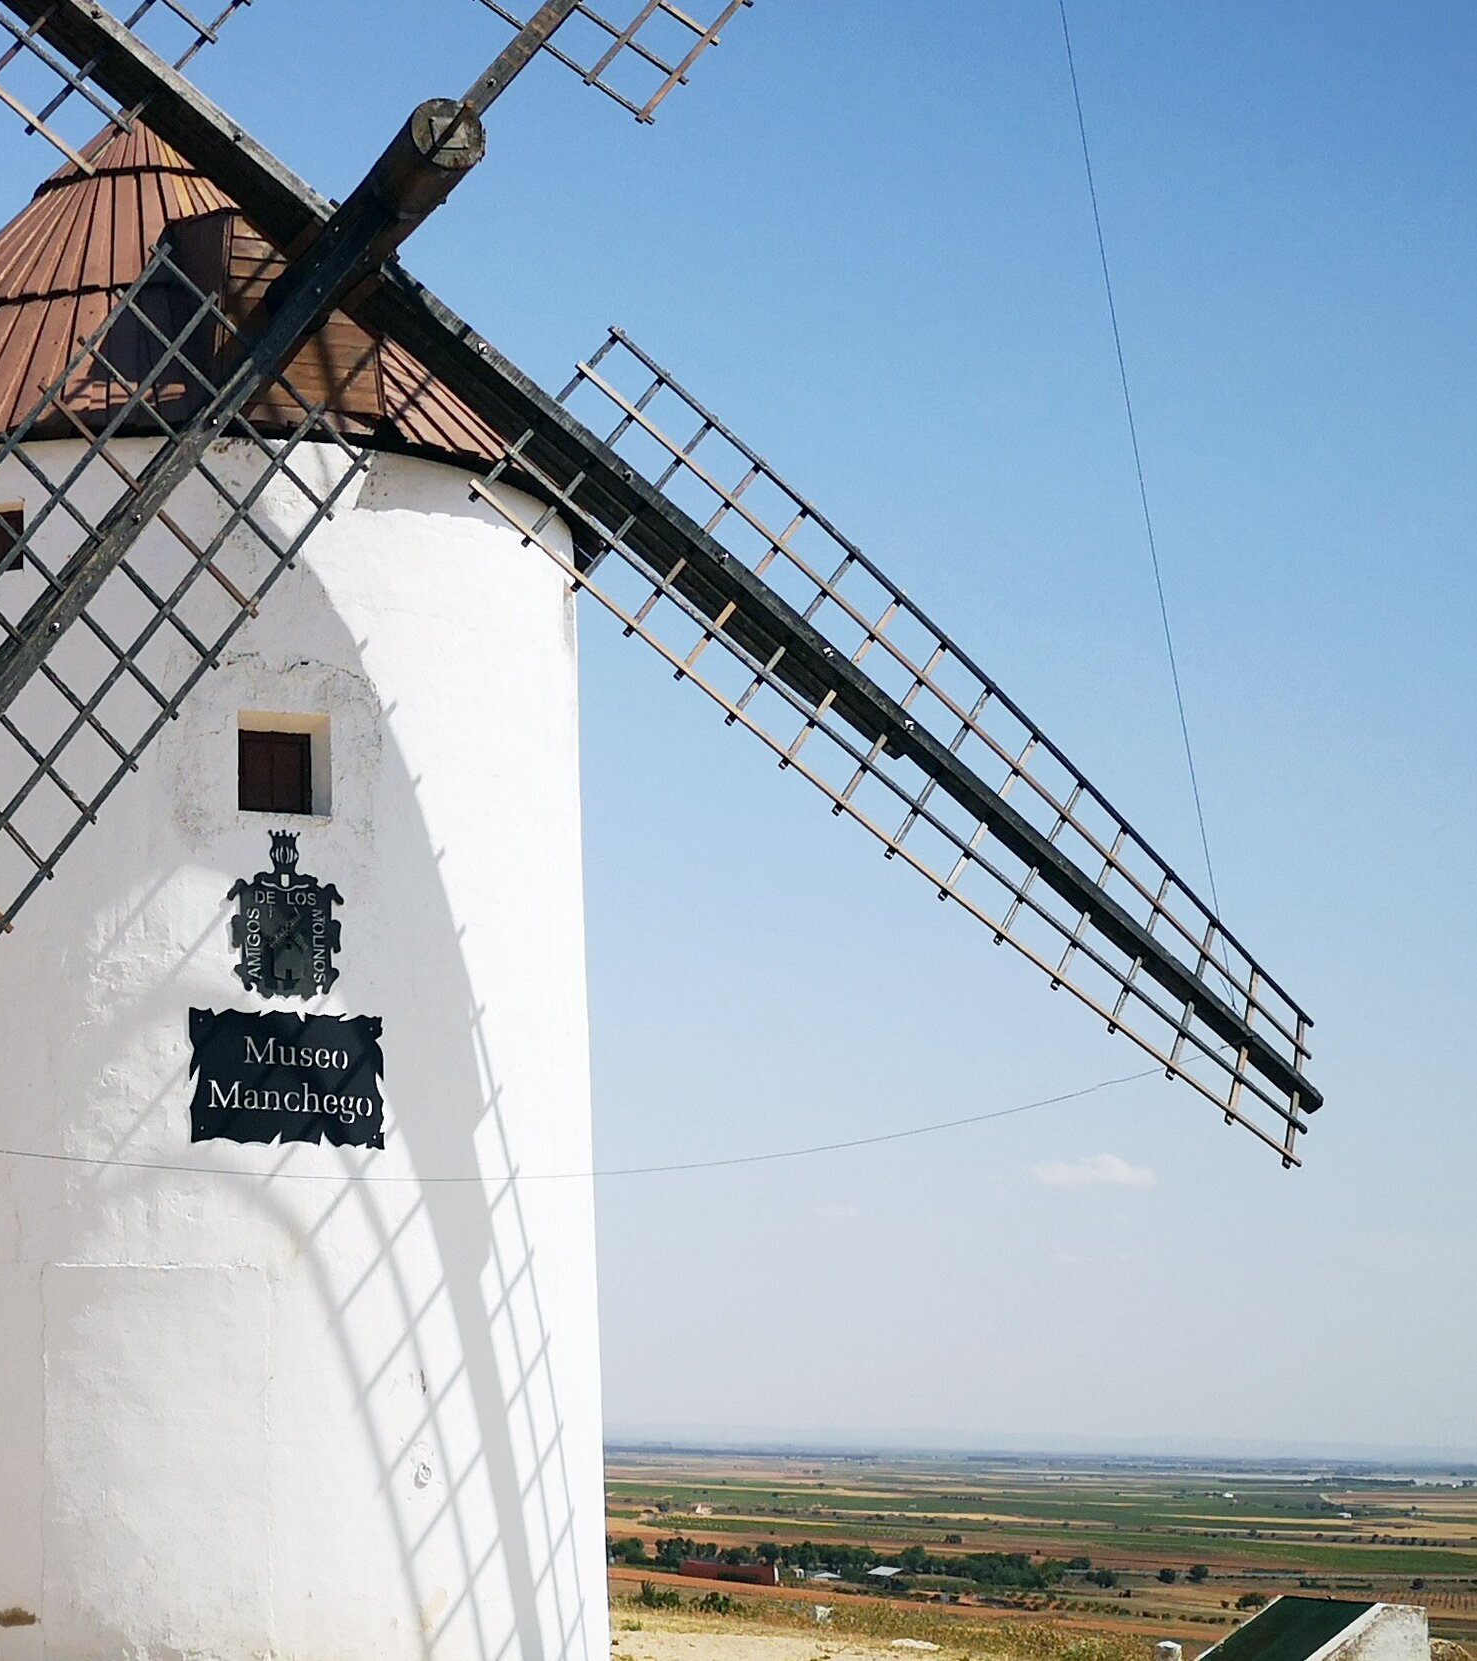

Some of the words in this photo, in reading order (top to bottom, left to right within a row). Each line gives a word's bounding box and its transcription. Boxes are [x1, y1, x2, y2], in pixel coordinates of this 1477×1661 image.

[254, 890, 276, 905] DE
[286, 891, 317, 906] LOS
[245, 907, 262, 980] AMIGOS
[311, 908, 327, 984] MOLINOS
[243, 1035, 349, 1070] Museo
[207, 1079, 373, 1124] Manchego
